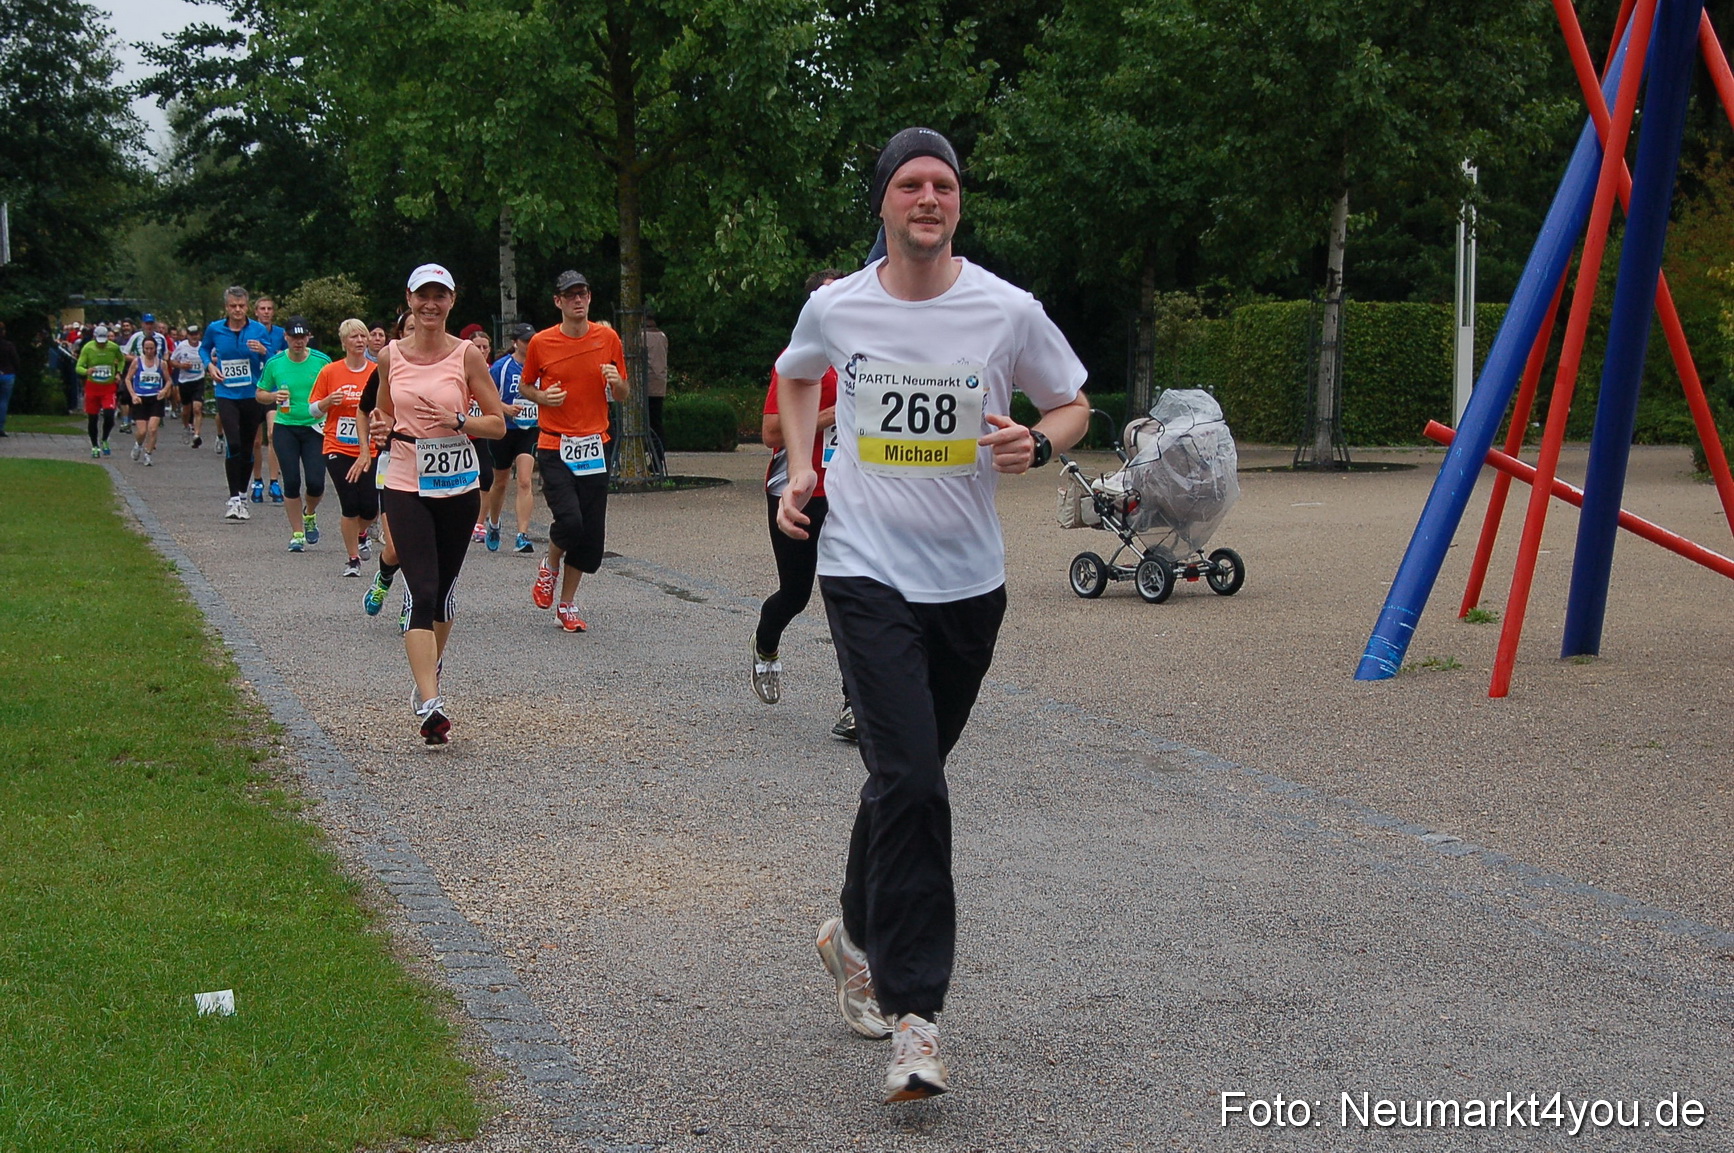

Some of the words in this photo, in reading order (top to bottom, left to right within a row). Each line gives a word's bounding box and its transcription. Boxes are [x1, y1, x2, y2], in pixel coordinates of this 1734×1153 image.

[224, 364, 248, 377] 2356
[858, 373, 899, 385] PARTL
[902, 375, 960, 387] Neumarkt
[880, 391, 957, 435] 268
[423, 447, 473, 474] 2870
[564, 441, 599, 461] 2675
[885, 444, 949, 463] Michael
